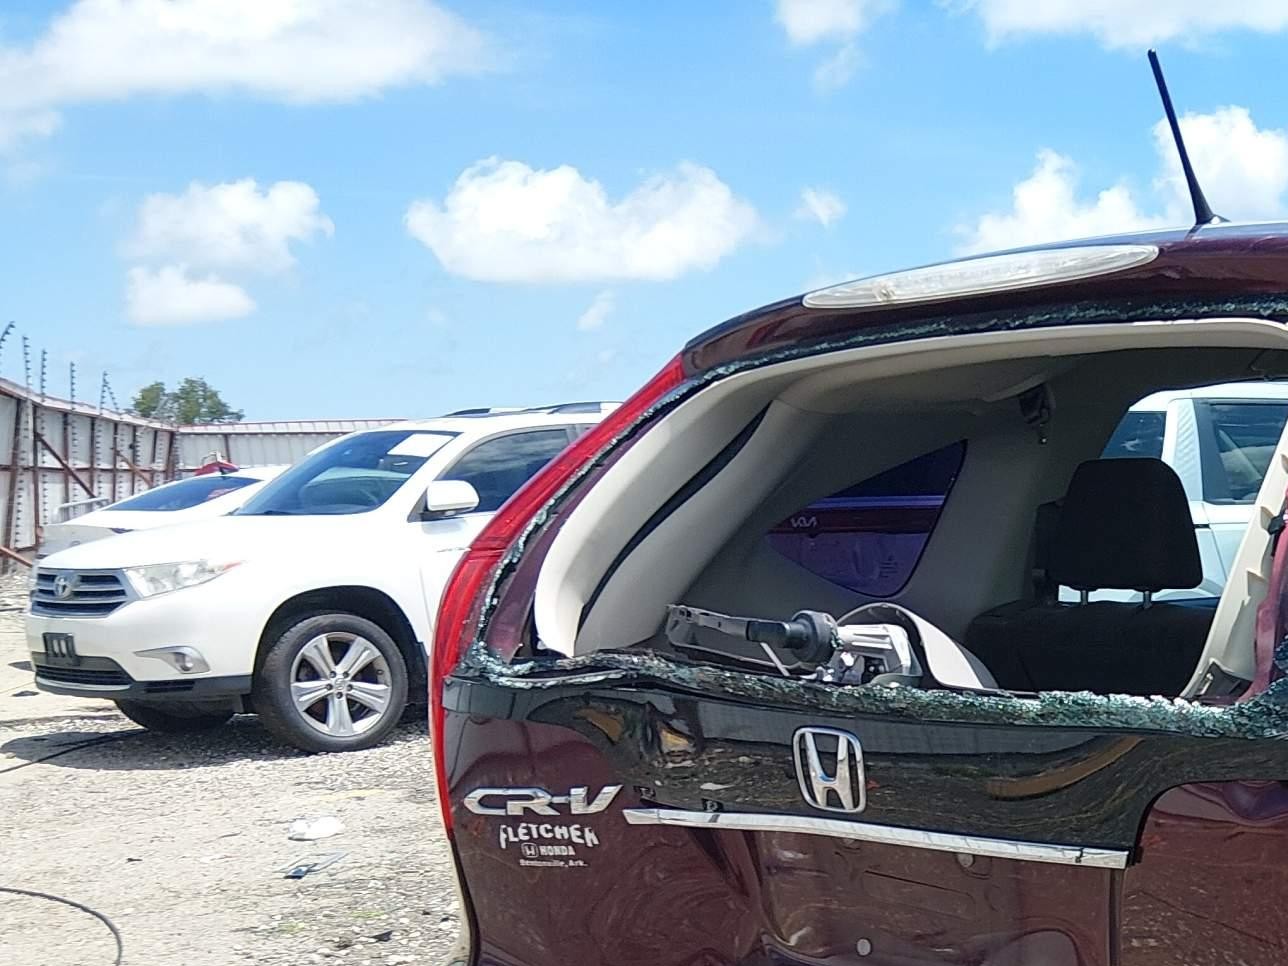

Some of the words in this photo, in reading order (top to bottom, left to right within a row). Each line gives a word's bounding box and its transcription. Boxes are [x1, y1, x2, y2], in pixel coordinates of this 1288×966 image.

[463, 784, 624, 816] CR-V
[500, 822, 600, 849] FLETCHER
[539, 846, 576, 856] HONDA
